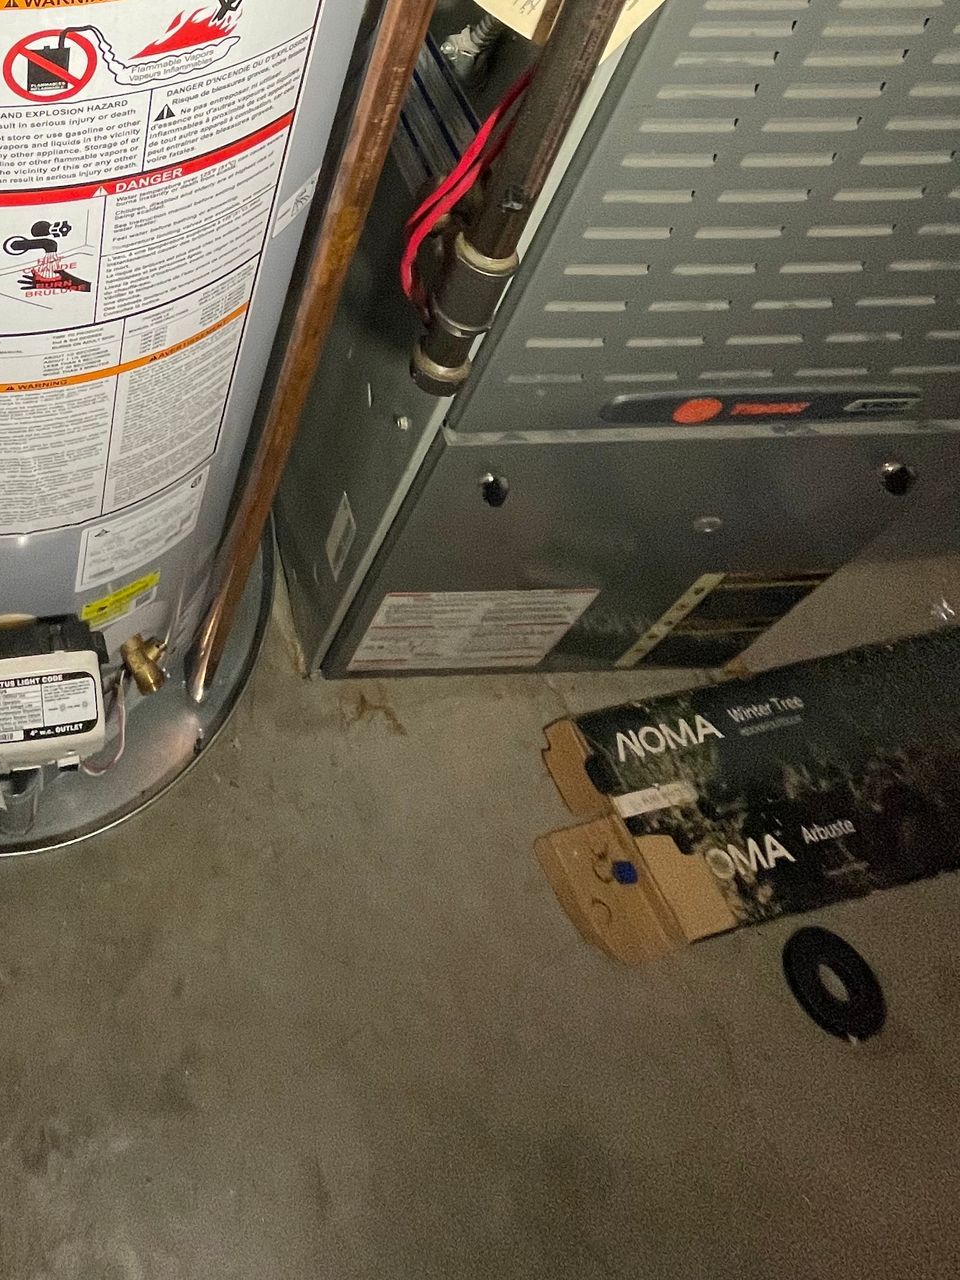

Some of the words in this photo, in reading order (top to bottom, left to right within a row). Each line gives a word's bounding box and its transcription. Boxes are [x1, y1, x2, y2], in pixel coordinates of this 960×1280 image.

[129, 71, 161, 81] Vapeurs
[164, 58, 213, 75] Inflammables
[131, 58, 182, 73] Flammable
[185, 50, 214, 62] Vapors
[167, 82, 204, 97] DANGER
[26, 107, 83, 118] EXPLOSION
[87, 100, 128, 112] HAZARD
[30, 119, 66, 128] serious
[69, 117, 95, 126] injury
[111, 109, 136, 119] death
[51, 139, 80, 148] liquids
[110, 128, 140, 141] vicinity
[66, 126, 103, 138] gasoline
[118, 119, 141, 130] other
[37, 147, 81, 158] appliance.
[85, 141, 117, 153] Storage
[54, 153, 98, 163] flammable
[100, 148, 127, 159] vapors
[14, 167, 47, 175] vicinity
[95, 159, 111, 167] any
[114, 154, 137, 163] other
[47, 173, 76, 181] serious
[79, 169, 101, 178] injury
[115, 168, 183, 193] DANGER
[36, 280, 72, 289] BURN
[17, 379, 68, 391] WARNING
[17, 678, 40, 686] LIGHT
[42, 674, 63, 684] CODE
[727, 703, 772, 722] Winter
[769, 696, 805, 712] Tree
[615, 713, 726, 762] NOMA
[705, 833, 796, 879] OMA
